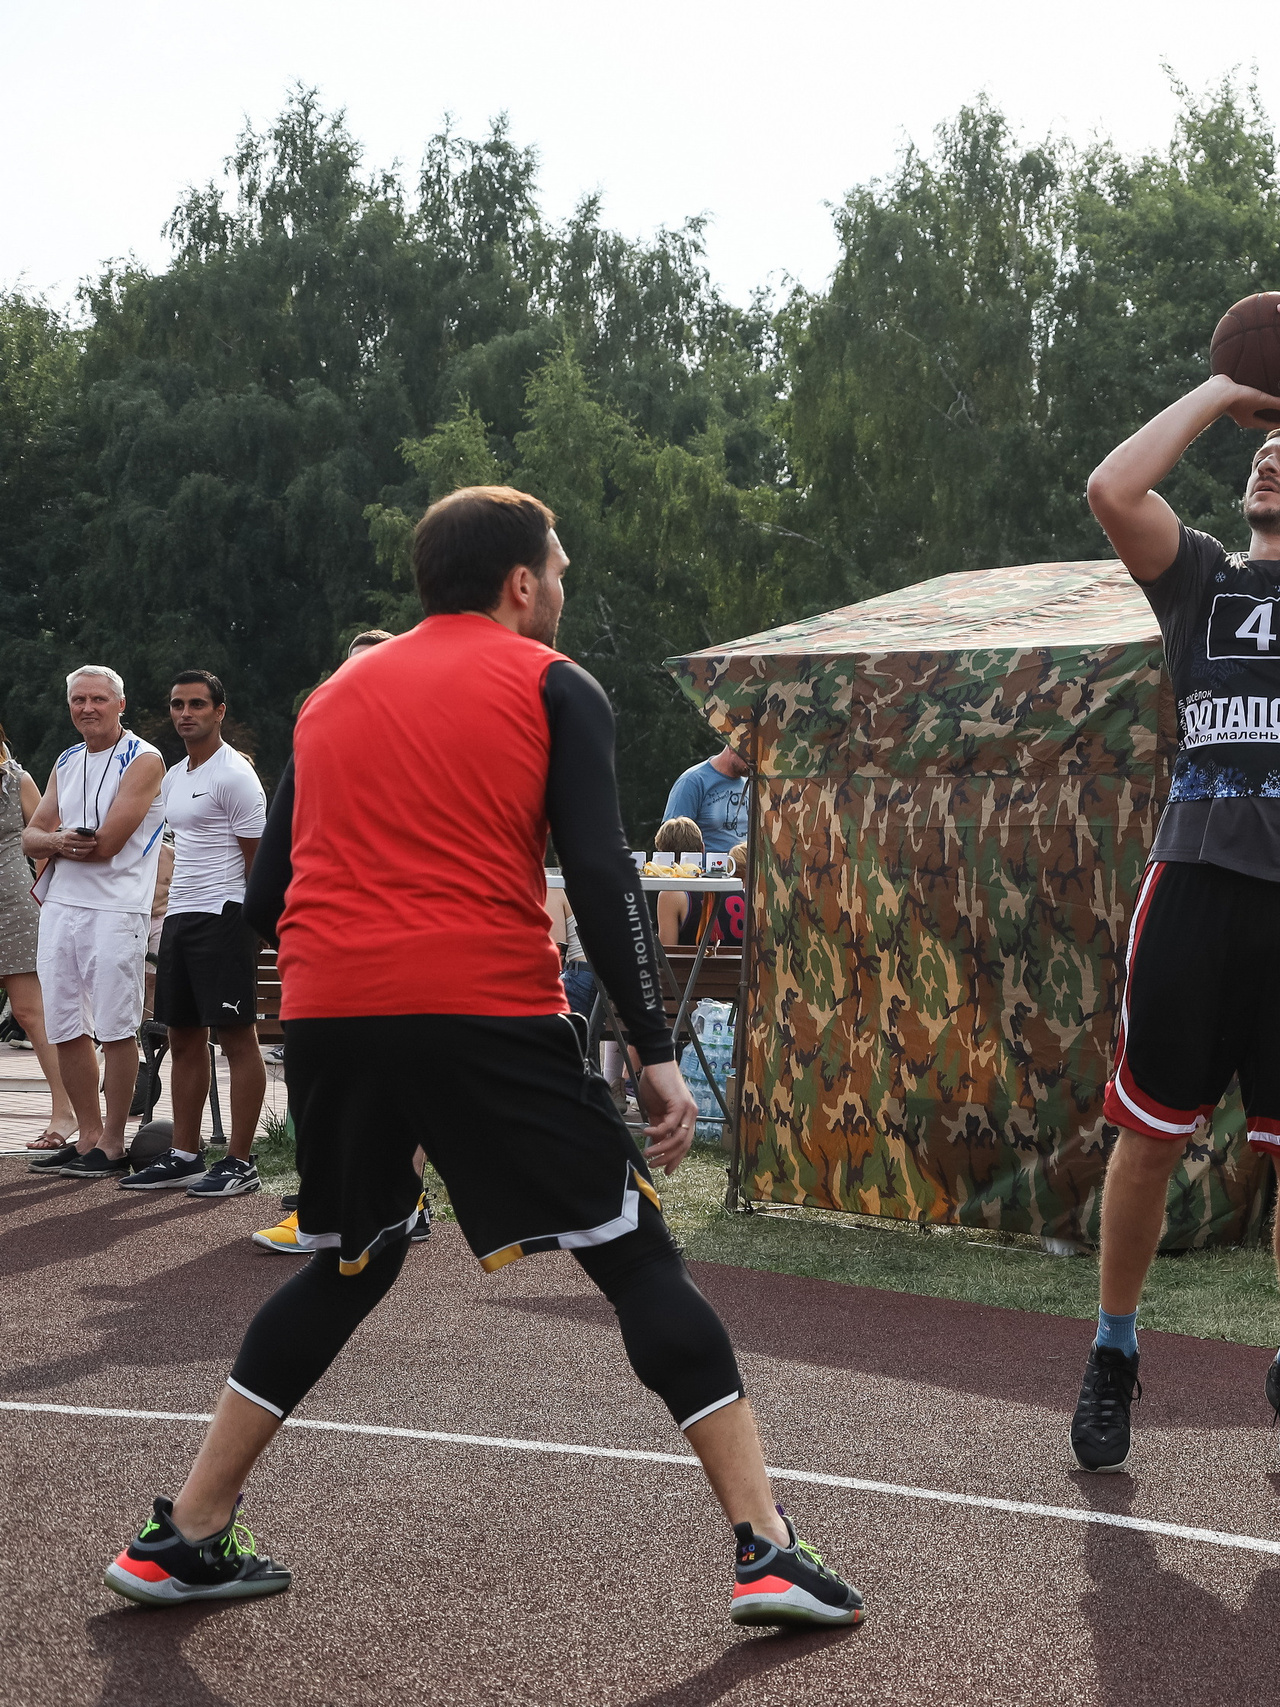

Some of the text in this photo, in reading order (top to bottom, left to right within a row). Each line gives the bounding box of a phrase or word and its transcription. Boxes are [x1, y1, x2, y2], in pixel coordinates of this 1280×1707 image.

[1187, 733, 1212, 746] Моя
[624, 892, 657, 1010] KEEP ROLLING
